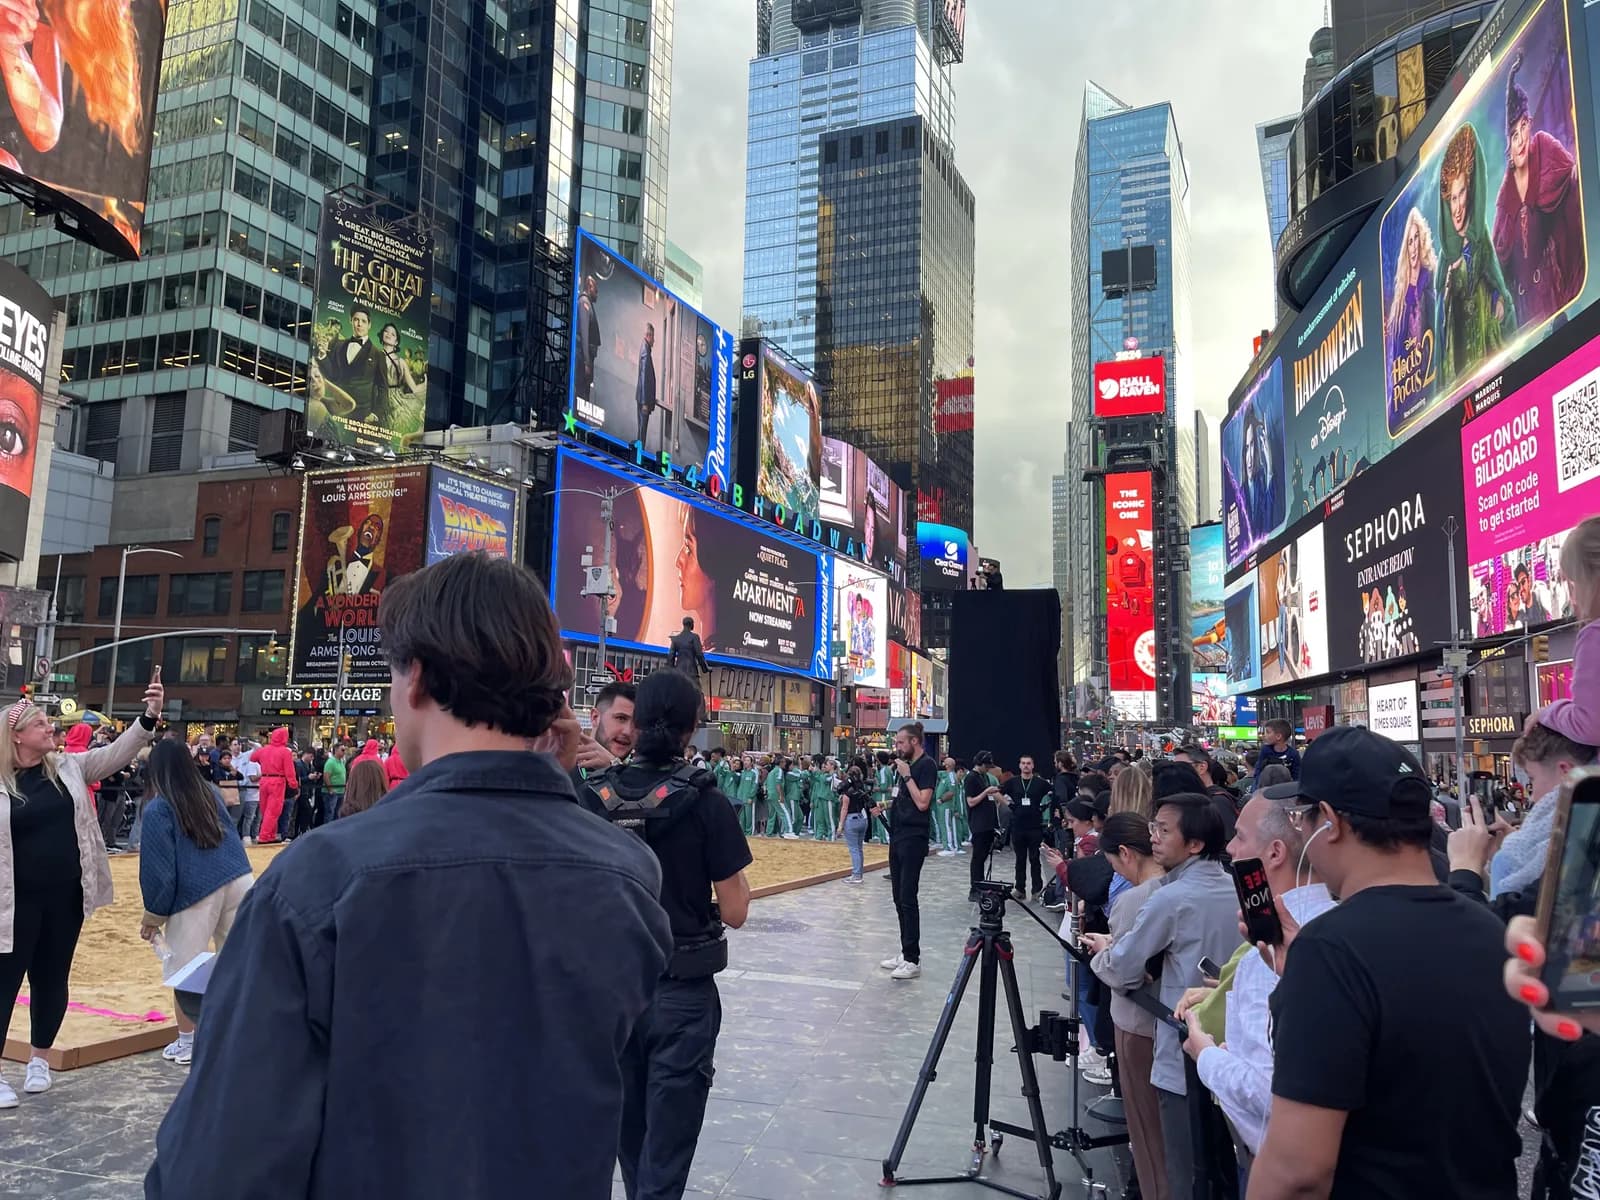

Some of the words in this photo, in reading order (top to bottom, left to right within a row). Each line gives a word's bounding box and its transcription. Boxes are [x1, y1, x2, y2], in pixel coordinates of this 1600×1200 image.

[354, 232, 410, 260] EXTRAVAGANZA
[371, 230, 384, 242] BIG
[385, 236, 424, 258] BROADWAY
[334, 245, 365, 276] THE
[368, 259, 424, 297] GREAT
[341, 272, 414, 313] GATSBY
[359, 298, 374, 310] NEW
[374, 303, 402, 319] MUSICAL
[1294, 279, 1364, 417] HALLOWEEN
[1421, 328, 1437, 389] 2
[743, 370, 755, 380] LG
[1475, 375, 1503, 402] MARRIOTT
[1475, 390, 1500, 412] MARQUIS
[1310, 433, 1319, 450] on
[1471, 434, 1492, 464] GET
[1493, 422, 1511, 452] ON
[1512, 406, 1540, 440] OUR
[1475, 435, 1538, 488] BILLBOARD
[347, 480, 395, 493] KNOCKOUT
[438, 482, 463, 497] MUSICAL
[488, 499, 511, 510] HISTORY
[459, 480, 472, 491] TIME
[473, 485, 480, 494] TO
[480, 487, 504, 500] CHANGE
[1119, 489, 1138, 498] THE
[1478, 492, 1499, 513] Scan
[1500, 481, 1513, 503] QR
[1515, 471, 1538, 495] code
[321, 493, 347, 503] LOUIS
[1112, 500, 1145, 509] ICONIC
[438, 495, 507, 535] BACK
[1119, 511, 1139, 520] ONE
[1479, 516, 1488, 532] to
[1490, 509, 1505, 532] get
[1505, 490, 1540, 521] started
[1345, 493, 1426, 563] SEPHORA
[1357, 559, 1389, 588] ENTRANCE
[1389, 546, 1415, 575] BELOW
[326, 593, 384, 608] WONDER
[733, 579, 794, 614] APARTMENT
[324, 608, 381, 628] WORL
[749, 611, 764, 624] NOW
[763, 614, 792, 631] STREAMING
[340, 627, 382, 643] OUIS
[310, 645, 376, 657] ARMSRONG
[262, 689, 303, 701] GIFTS
[718, 669, 776, 702] FOREVER
[1376, 698, 1397, 712] HEART
[1398, 697, 1408, 710] OF
[1374, 717, 1389, 729] TIMES
[1389, 716, 1412, 729] SQUARE
[1469, 716, 1515, 733] SEPHORA
